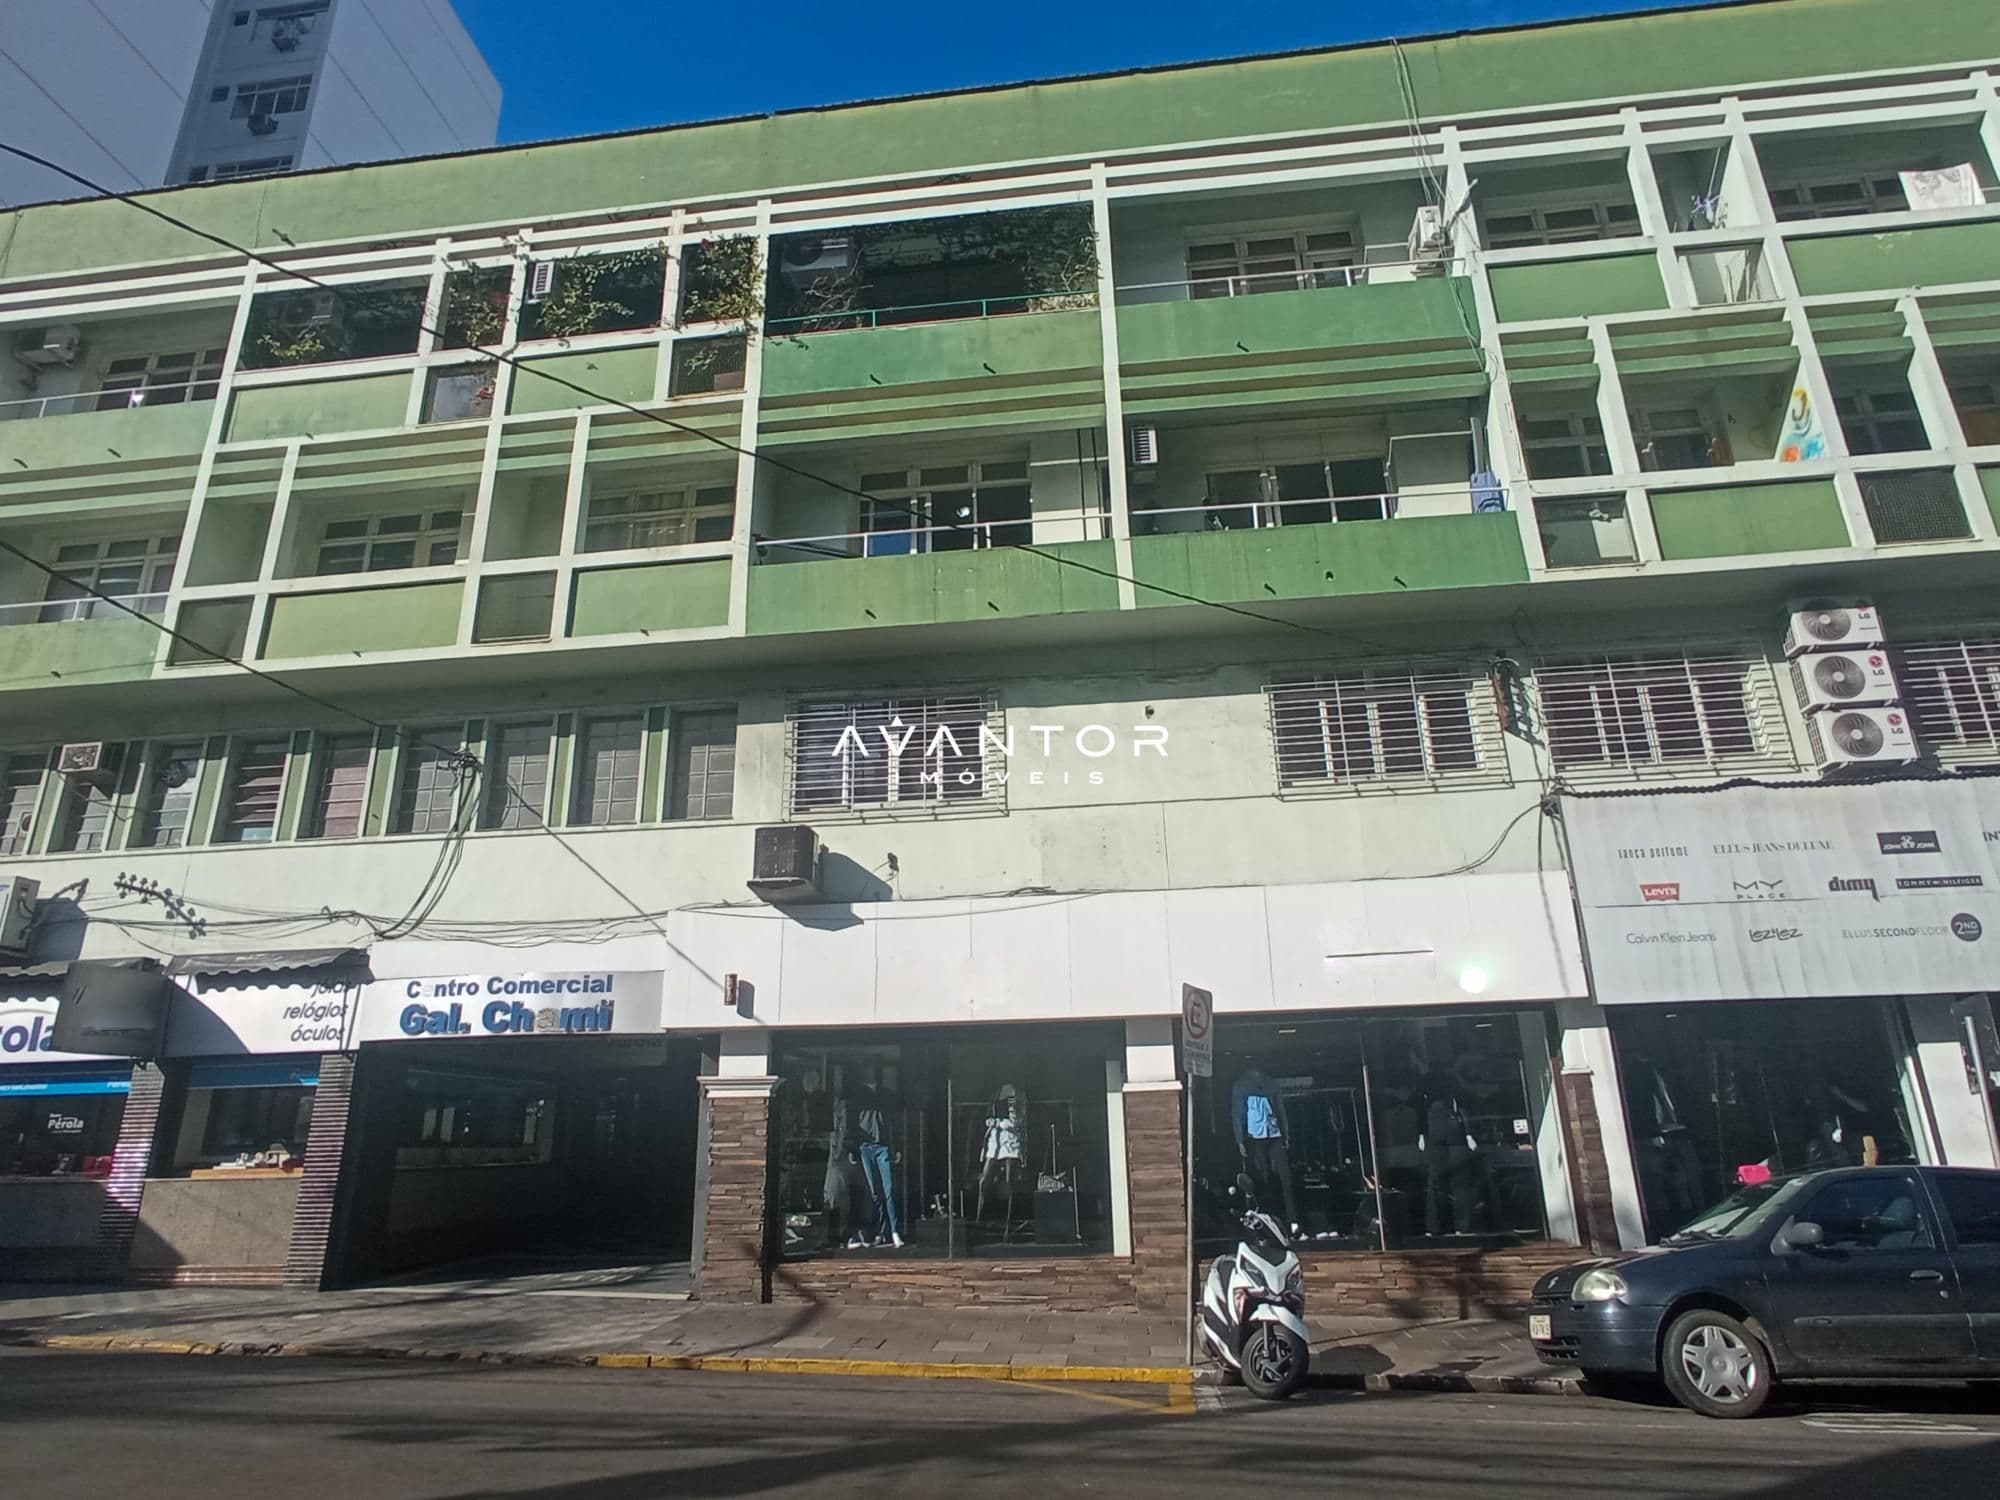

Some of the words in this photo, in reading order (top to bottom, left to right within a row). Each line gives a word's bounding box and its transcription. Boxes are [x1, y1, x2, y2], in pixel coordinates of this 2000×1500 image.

[1858, 612, 1871, 620] LG
[1872, 668, 1885, 676] LG
[1891, 727, 1904, 735] LG
[1733, 880, 1784, 891] MY
[1736, 892, 1785, 900] PLACE
[406, 979, 480, 998] Cntro
[486, 974, 614, 995] Comercial
[400, 1003, 472, 1036] Gal.
